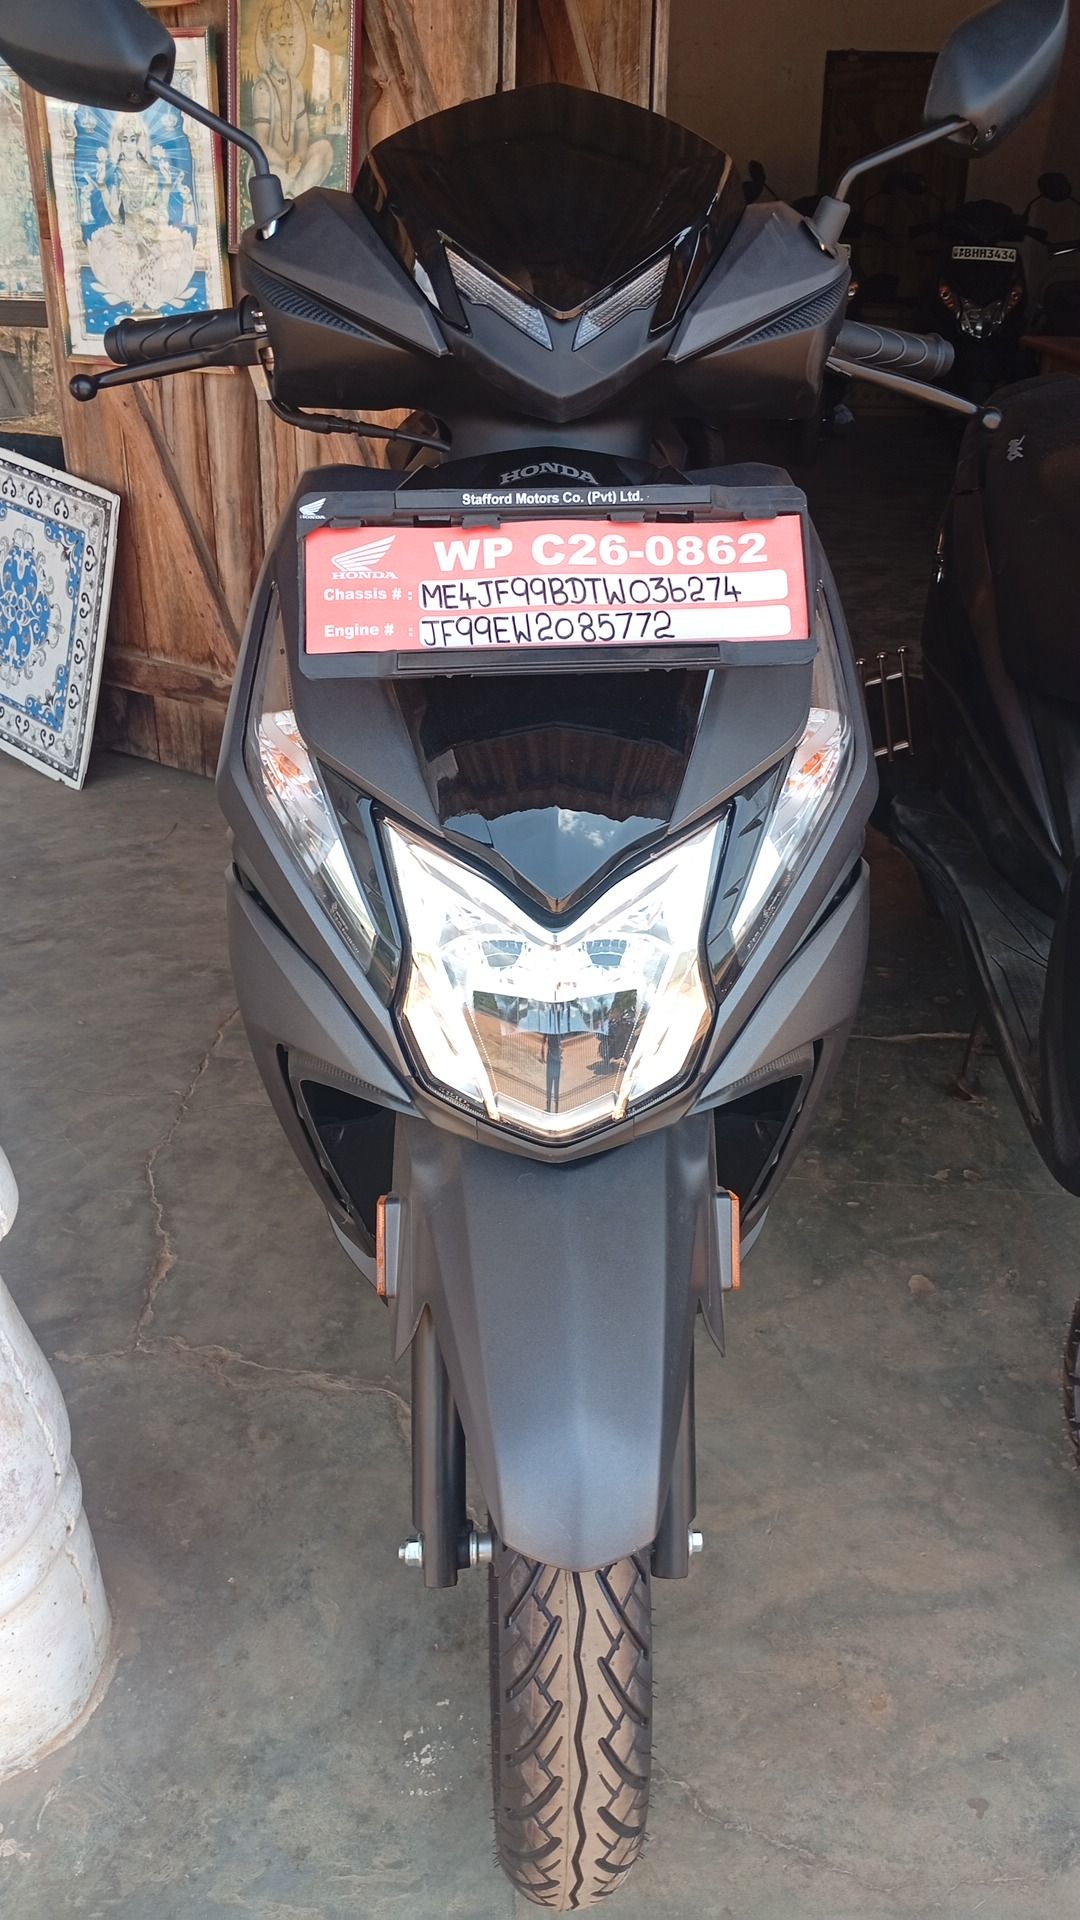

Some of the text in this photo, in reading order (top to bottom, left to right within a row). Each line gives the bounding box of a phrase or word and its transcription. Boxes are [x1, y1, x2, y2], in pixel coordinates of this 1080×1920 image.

[500, 462, 600, 485] HONDA
[462, 490, 644, 505] Stafford Motors Co. (Pvt) Ltd.
[433, 533, 768, 572] WP C26-0862
[331, 571, 399, 580] HONDA
[324, 588, 387, 601] Chassis
[324, 624, 380, 640] Engine
